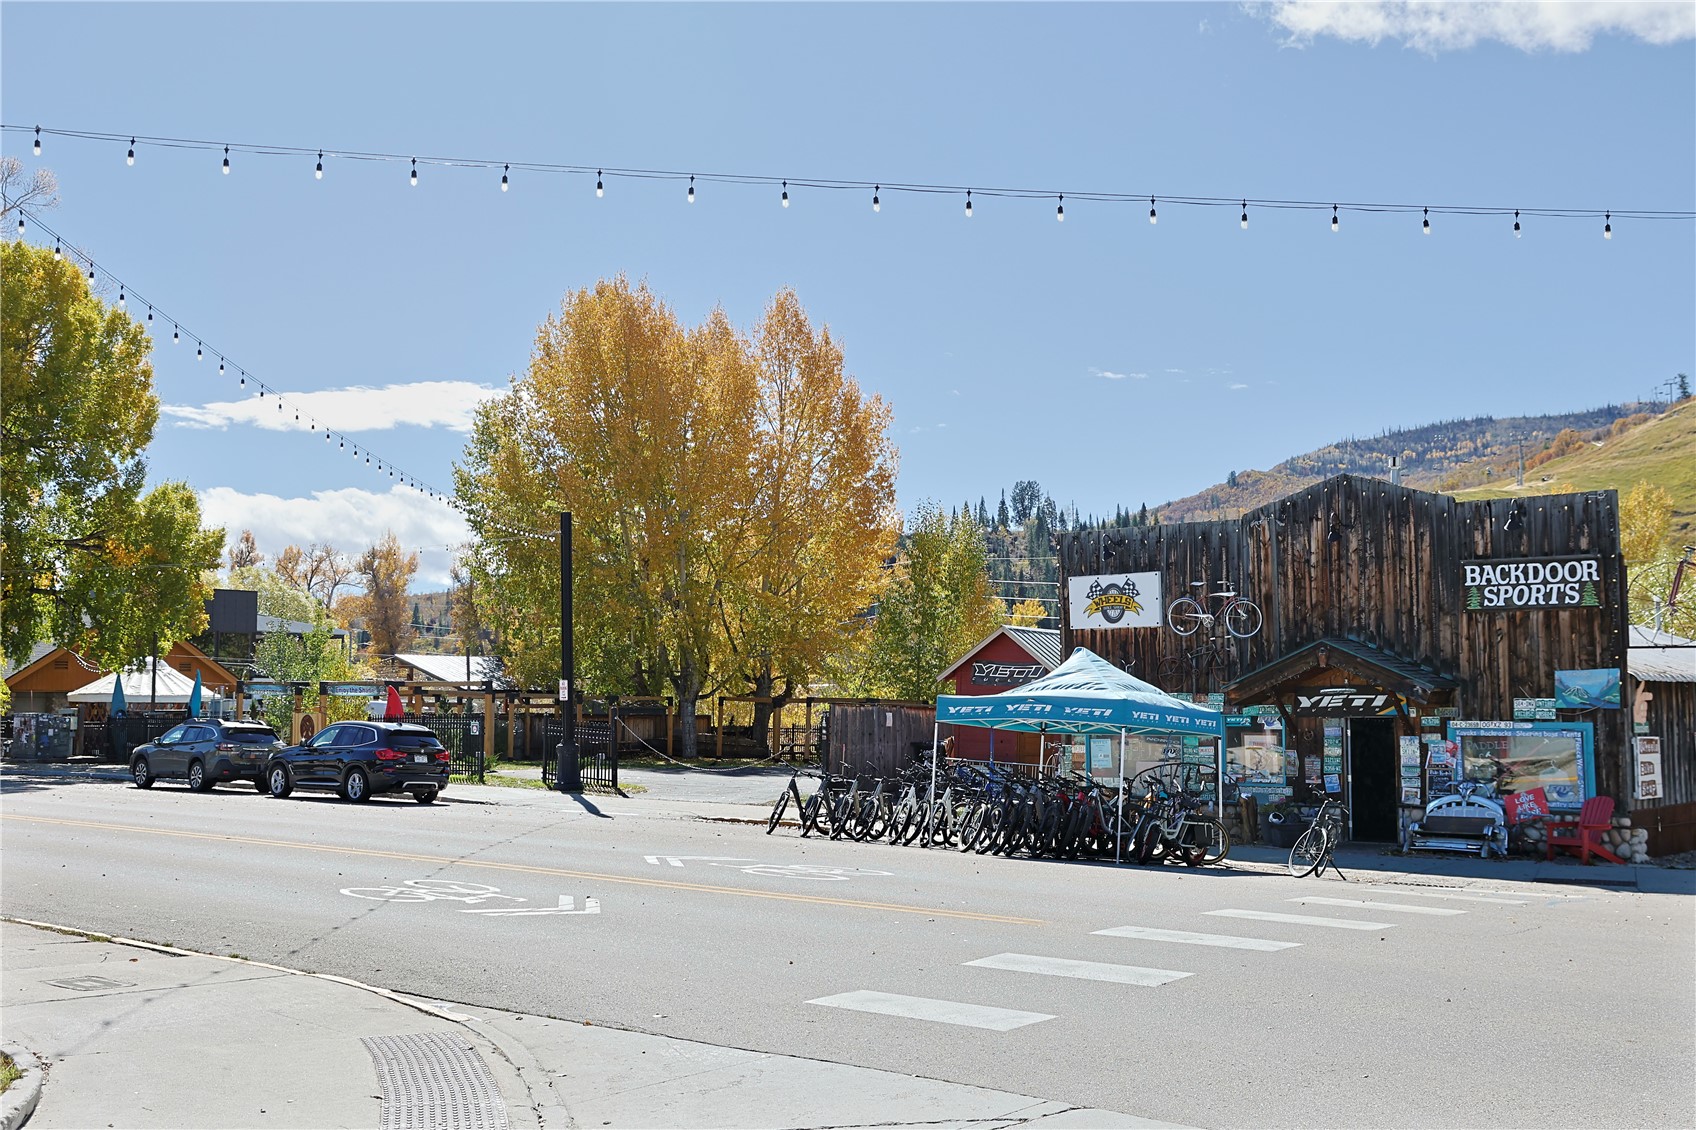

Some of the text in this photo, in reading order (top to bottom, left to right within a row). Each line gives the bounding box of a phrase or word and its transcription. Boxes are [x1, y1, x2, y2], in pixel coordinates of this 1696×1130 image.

[1464, 560, 1600, 586] BACKDOOR
[1484, 583, 1580, 607] SPORTS
[1093, 596, 1132, 607] WHEELS
[973, 663, 1045, 678] YETI
[1297, 694, 1389, 707] YETI
[948, 705, 994, 714] YETI
[1006, 704, 1052, 712] YETI
[1064, 707, 1113, 716] YETI
[1132, 711, 1160, 720] YETI
[1165, 714, 1190, 724] YETI
[1194, 718, 1217, 727] YETI
[1466, 740, 1509, 751] PADDLE
[1515, 794, 1535, 804] LOVE
